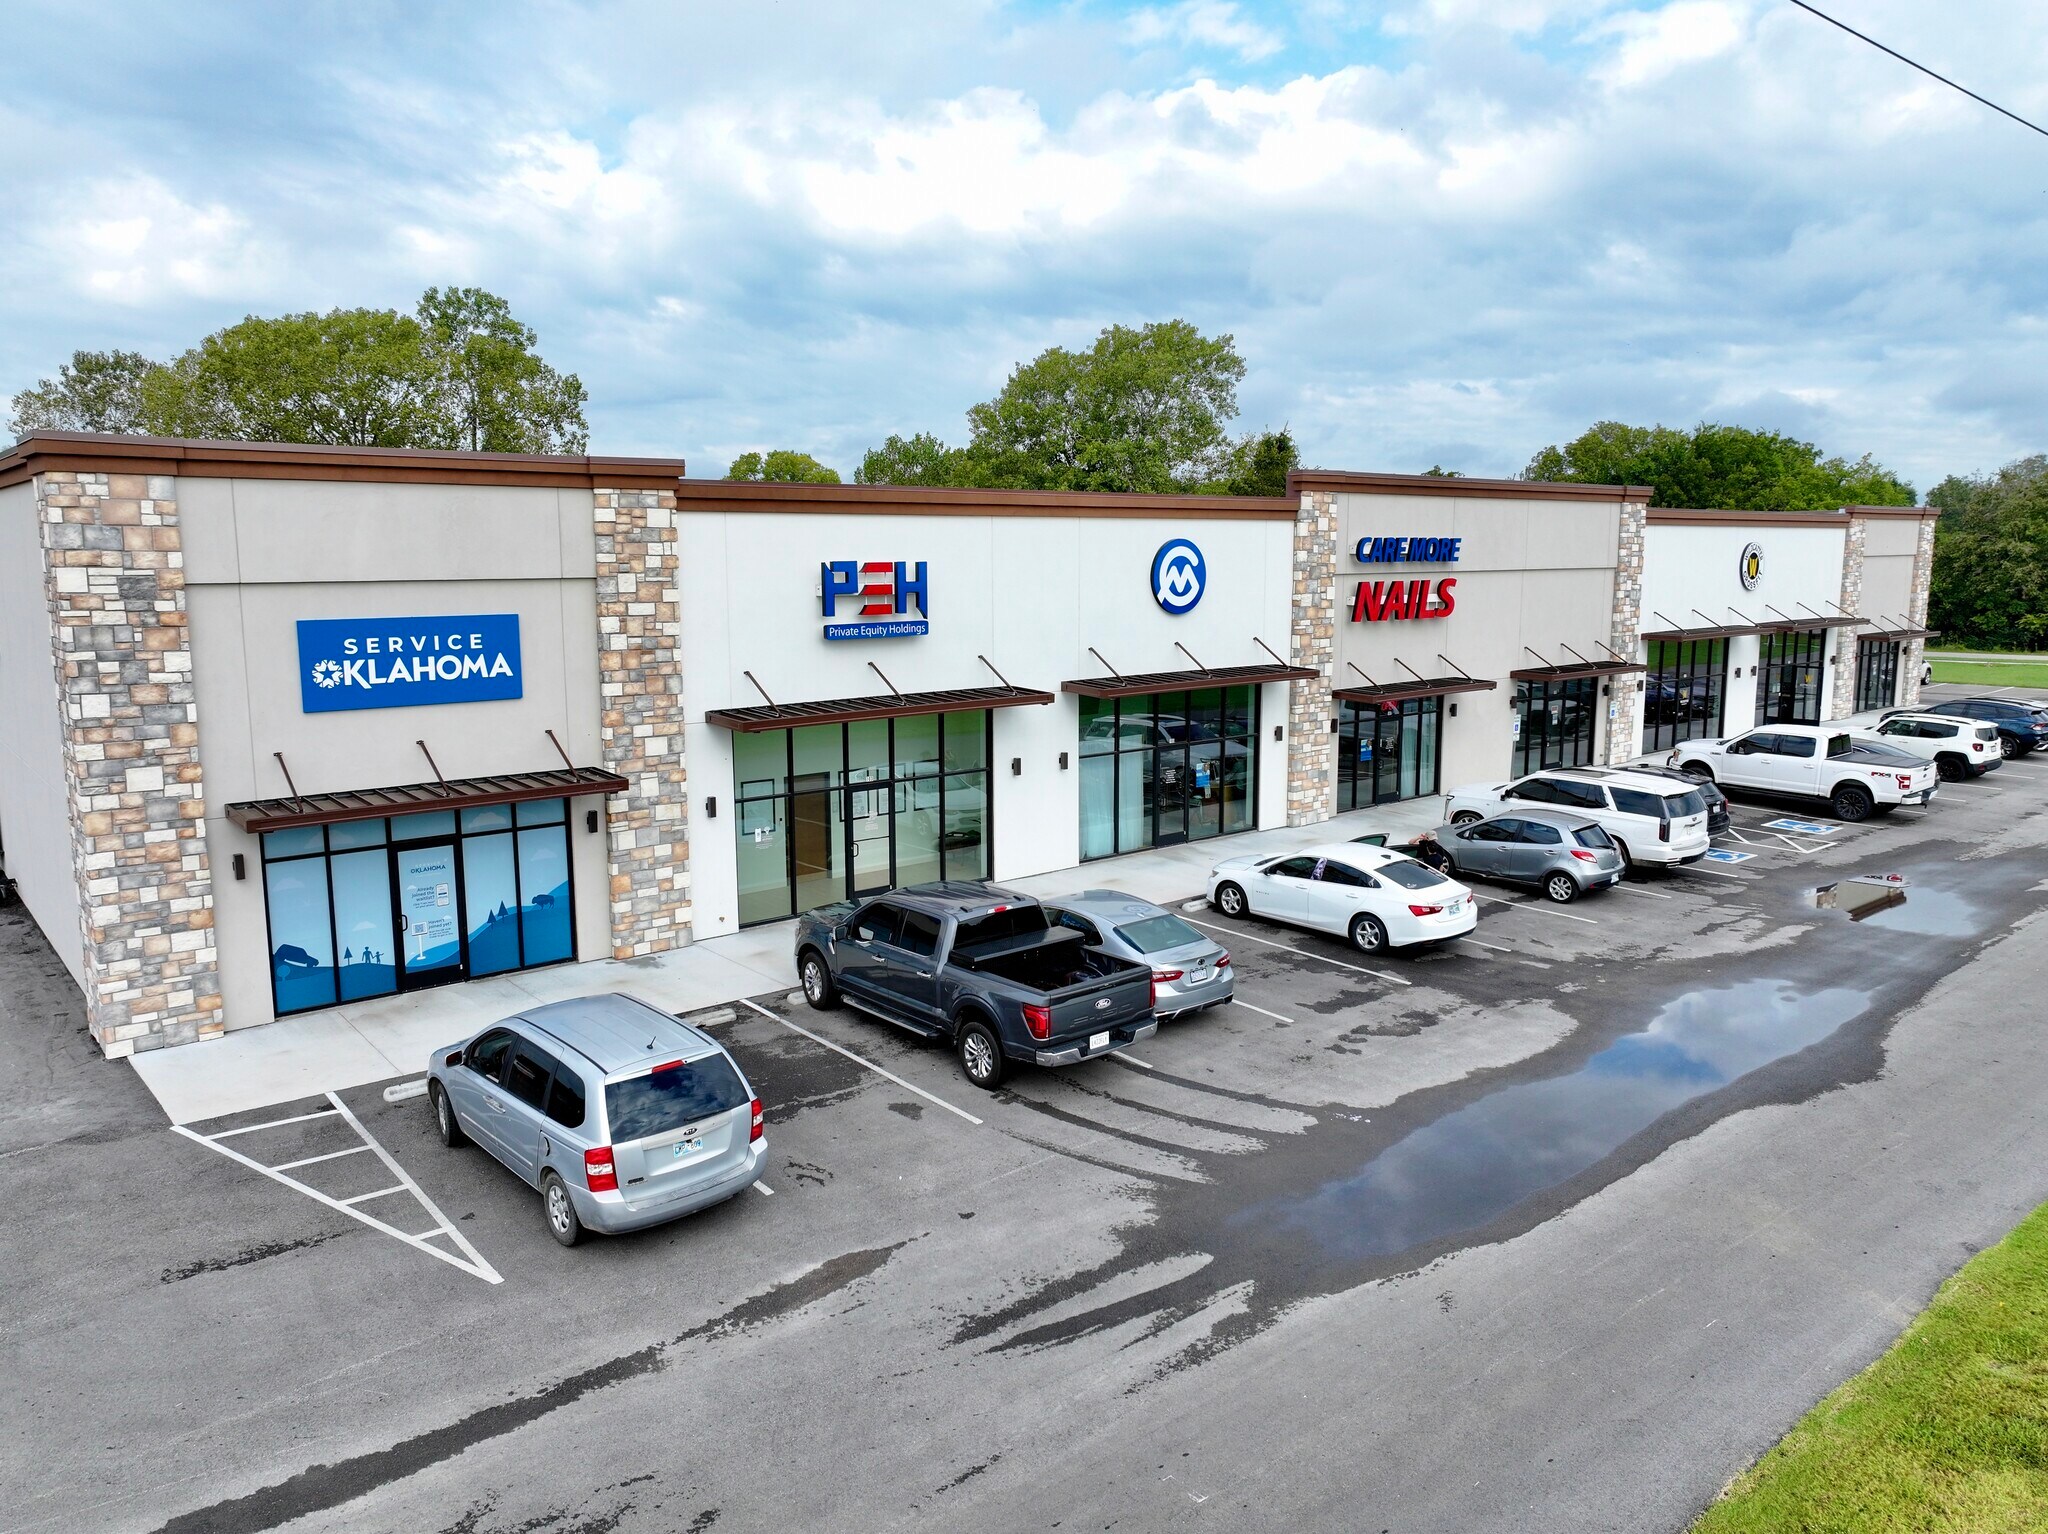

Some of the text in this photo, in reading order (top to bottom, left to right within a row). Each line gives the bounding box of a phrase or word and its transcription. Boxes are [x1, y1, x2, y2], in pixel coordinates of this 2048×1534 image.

[1356, 537, 1462, 563] CARE MORE
[821, 560, 928, 620] PEH
[1351, 577, 1457, 623] NAILS
[829, 623, 926, 637] Private Equity Holdings
[343, 633, 483, 655] SERVICE
[410, 864, 446, 874] OKLAHOMA
